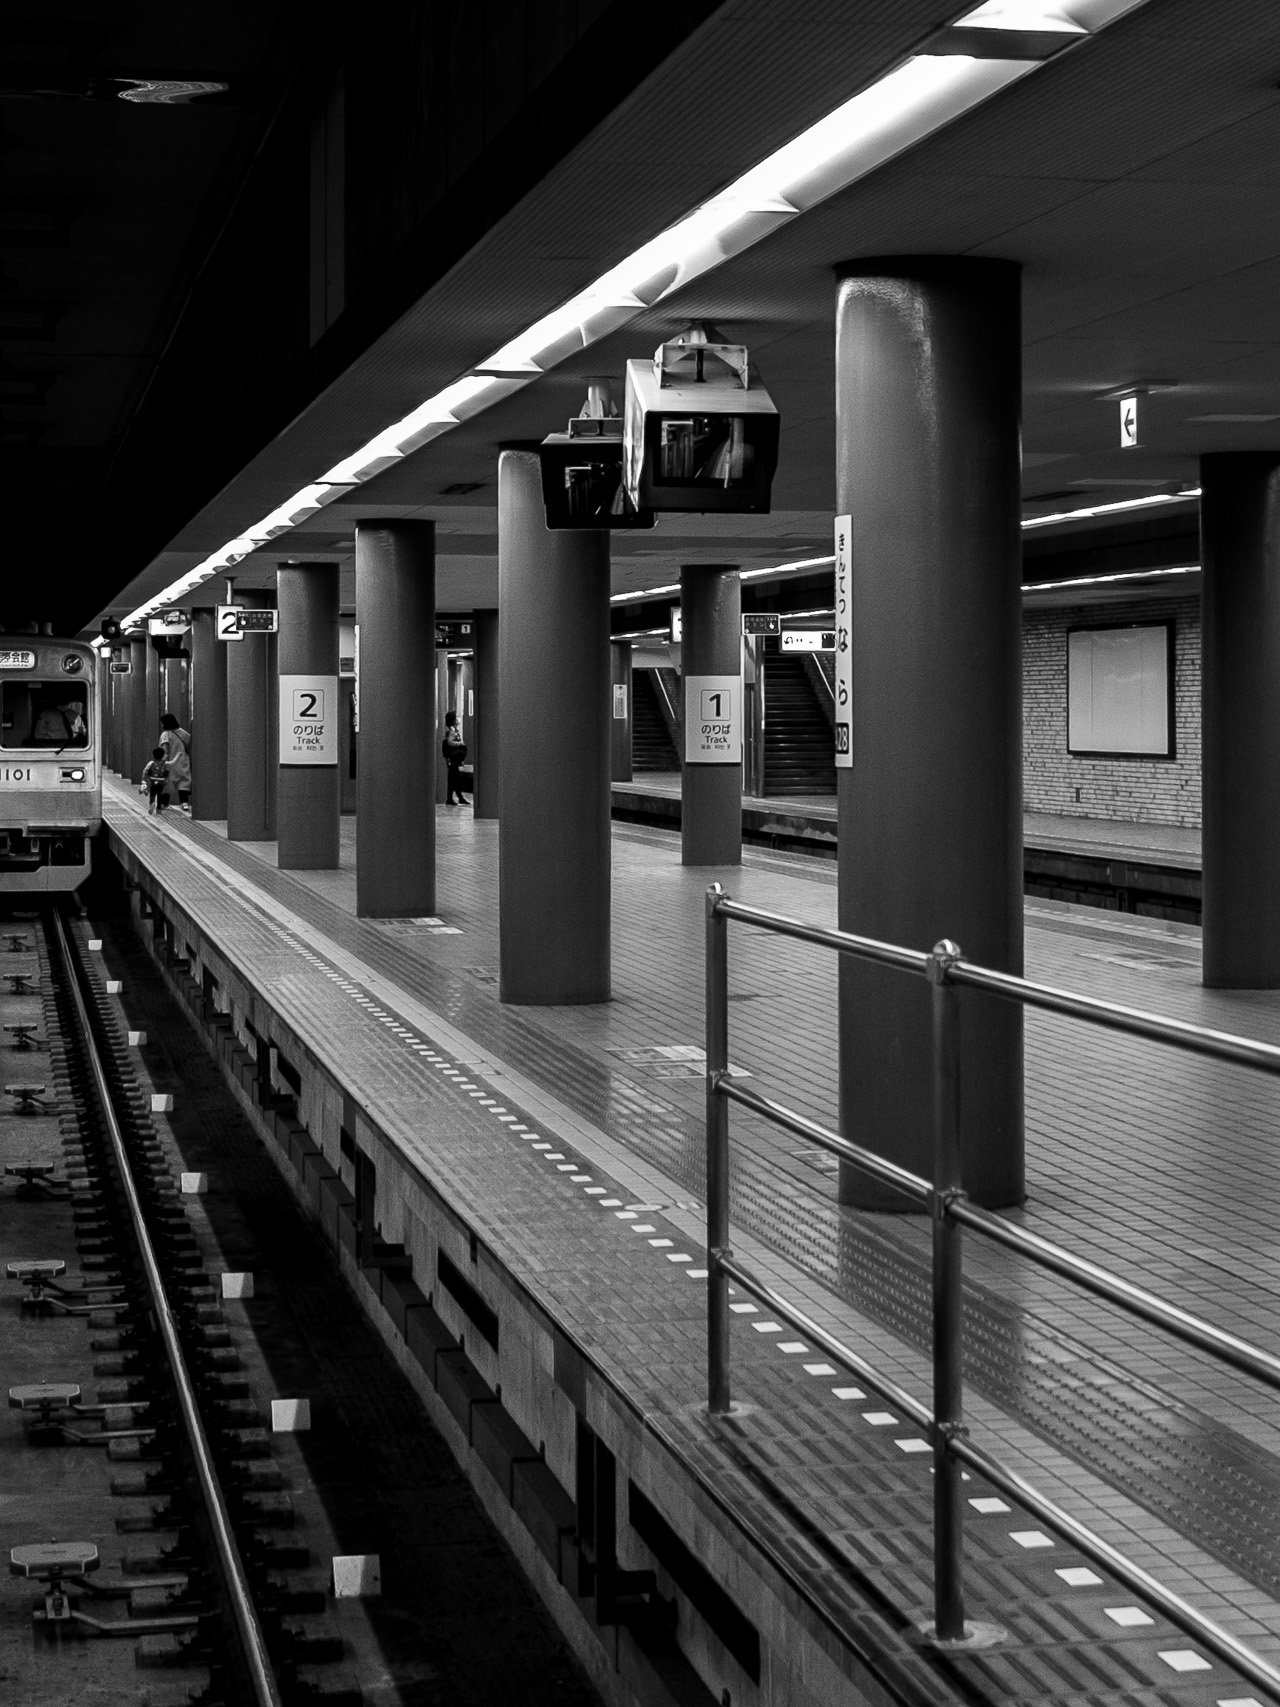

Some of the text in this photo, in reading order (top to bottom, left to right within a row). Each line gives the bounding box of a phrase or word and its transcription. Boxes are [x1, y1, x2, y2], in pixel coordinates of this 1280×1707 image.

[221, 611, 240, 634] 2
[299, 693, 318, 718] 2
[708, 693, 721, 717] 1
[293, 725, 324, 735] のりば
[701, 724, 731, 734] のりば
[296, 736, 321, 745] Track
[705, 736, 728, 744] Track
